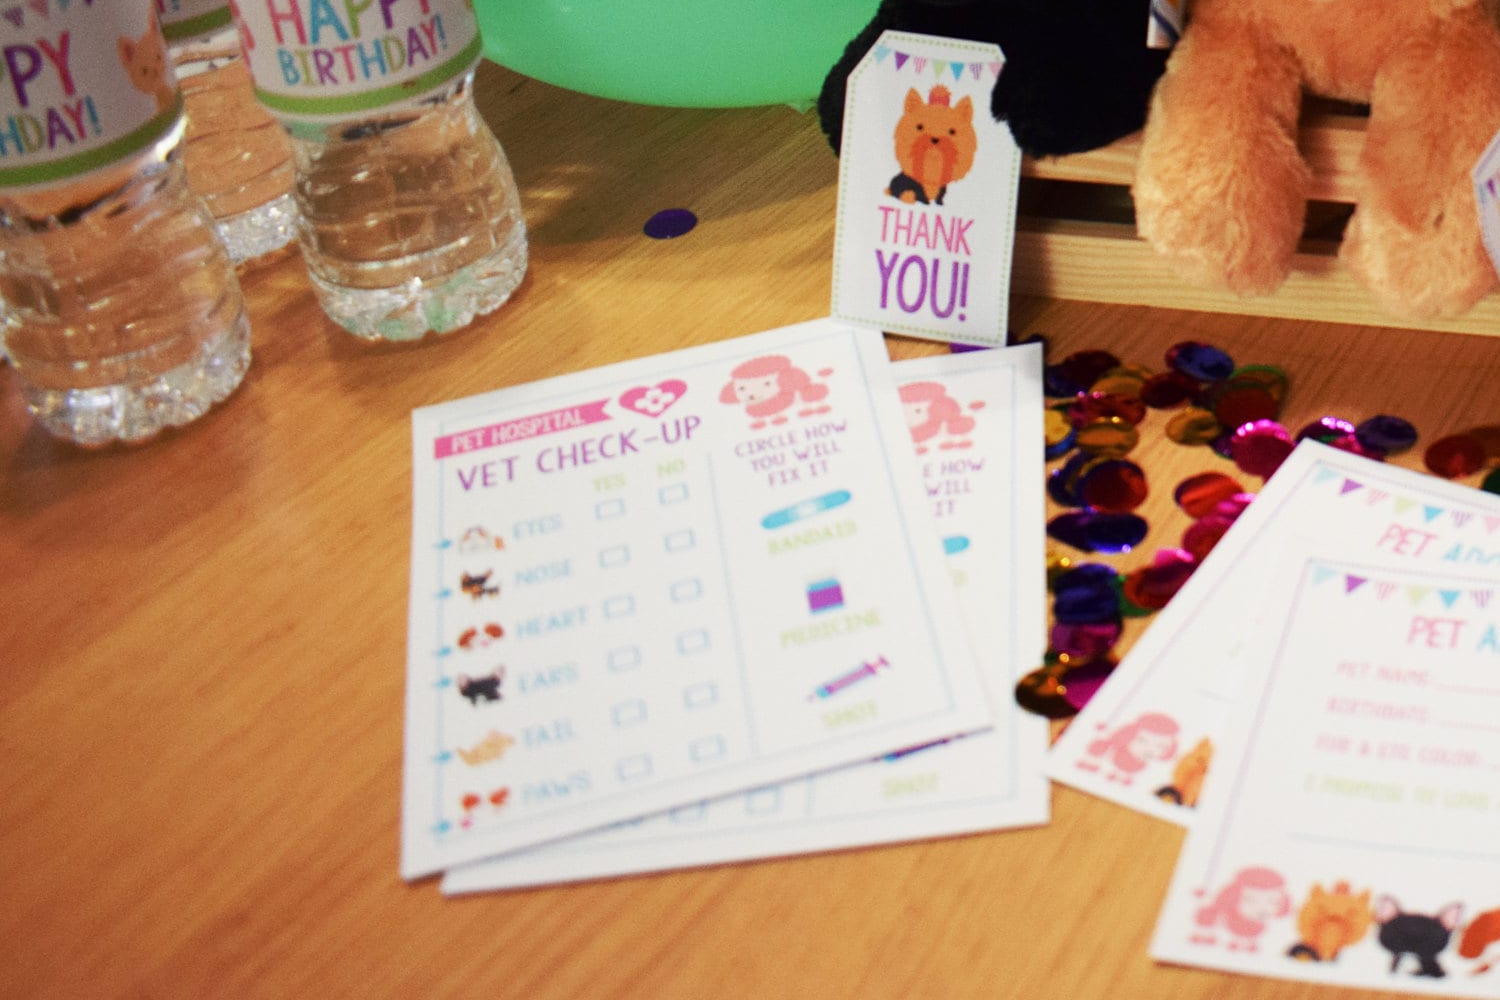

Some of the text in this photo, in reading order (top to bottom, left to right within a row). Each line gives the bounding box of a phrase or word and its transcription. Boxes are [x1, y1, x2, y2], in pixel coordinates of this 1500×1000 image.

[277, 19, 449, 87] BIRTHDAY!
[879, 205, 975, 255] THANK
[875, 249, 970, 322] YOU!
[452, 409, 585, 451] PET HOSPITAL
[734, 419, 848, 458] CIRCLE HOW
[457, 415, 702, 492] VET CHECK-UP
[751, 441, 841, 473] YOU WILL
[941, 457, 986, 475] HOW
[593, 458, 686, 492] YES NO
[768, 461, 830, 488] FIX IT
[926, 480, 972, 498] WILL
[934, 499, 957, 517] IT
[1376, 523, 1440, 557] PET
[514, 558, 573, 586] NOSE
[516, 605, 589, 638] HEART
[1407, 615, 1467, 648] PET
